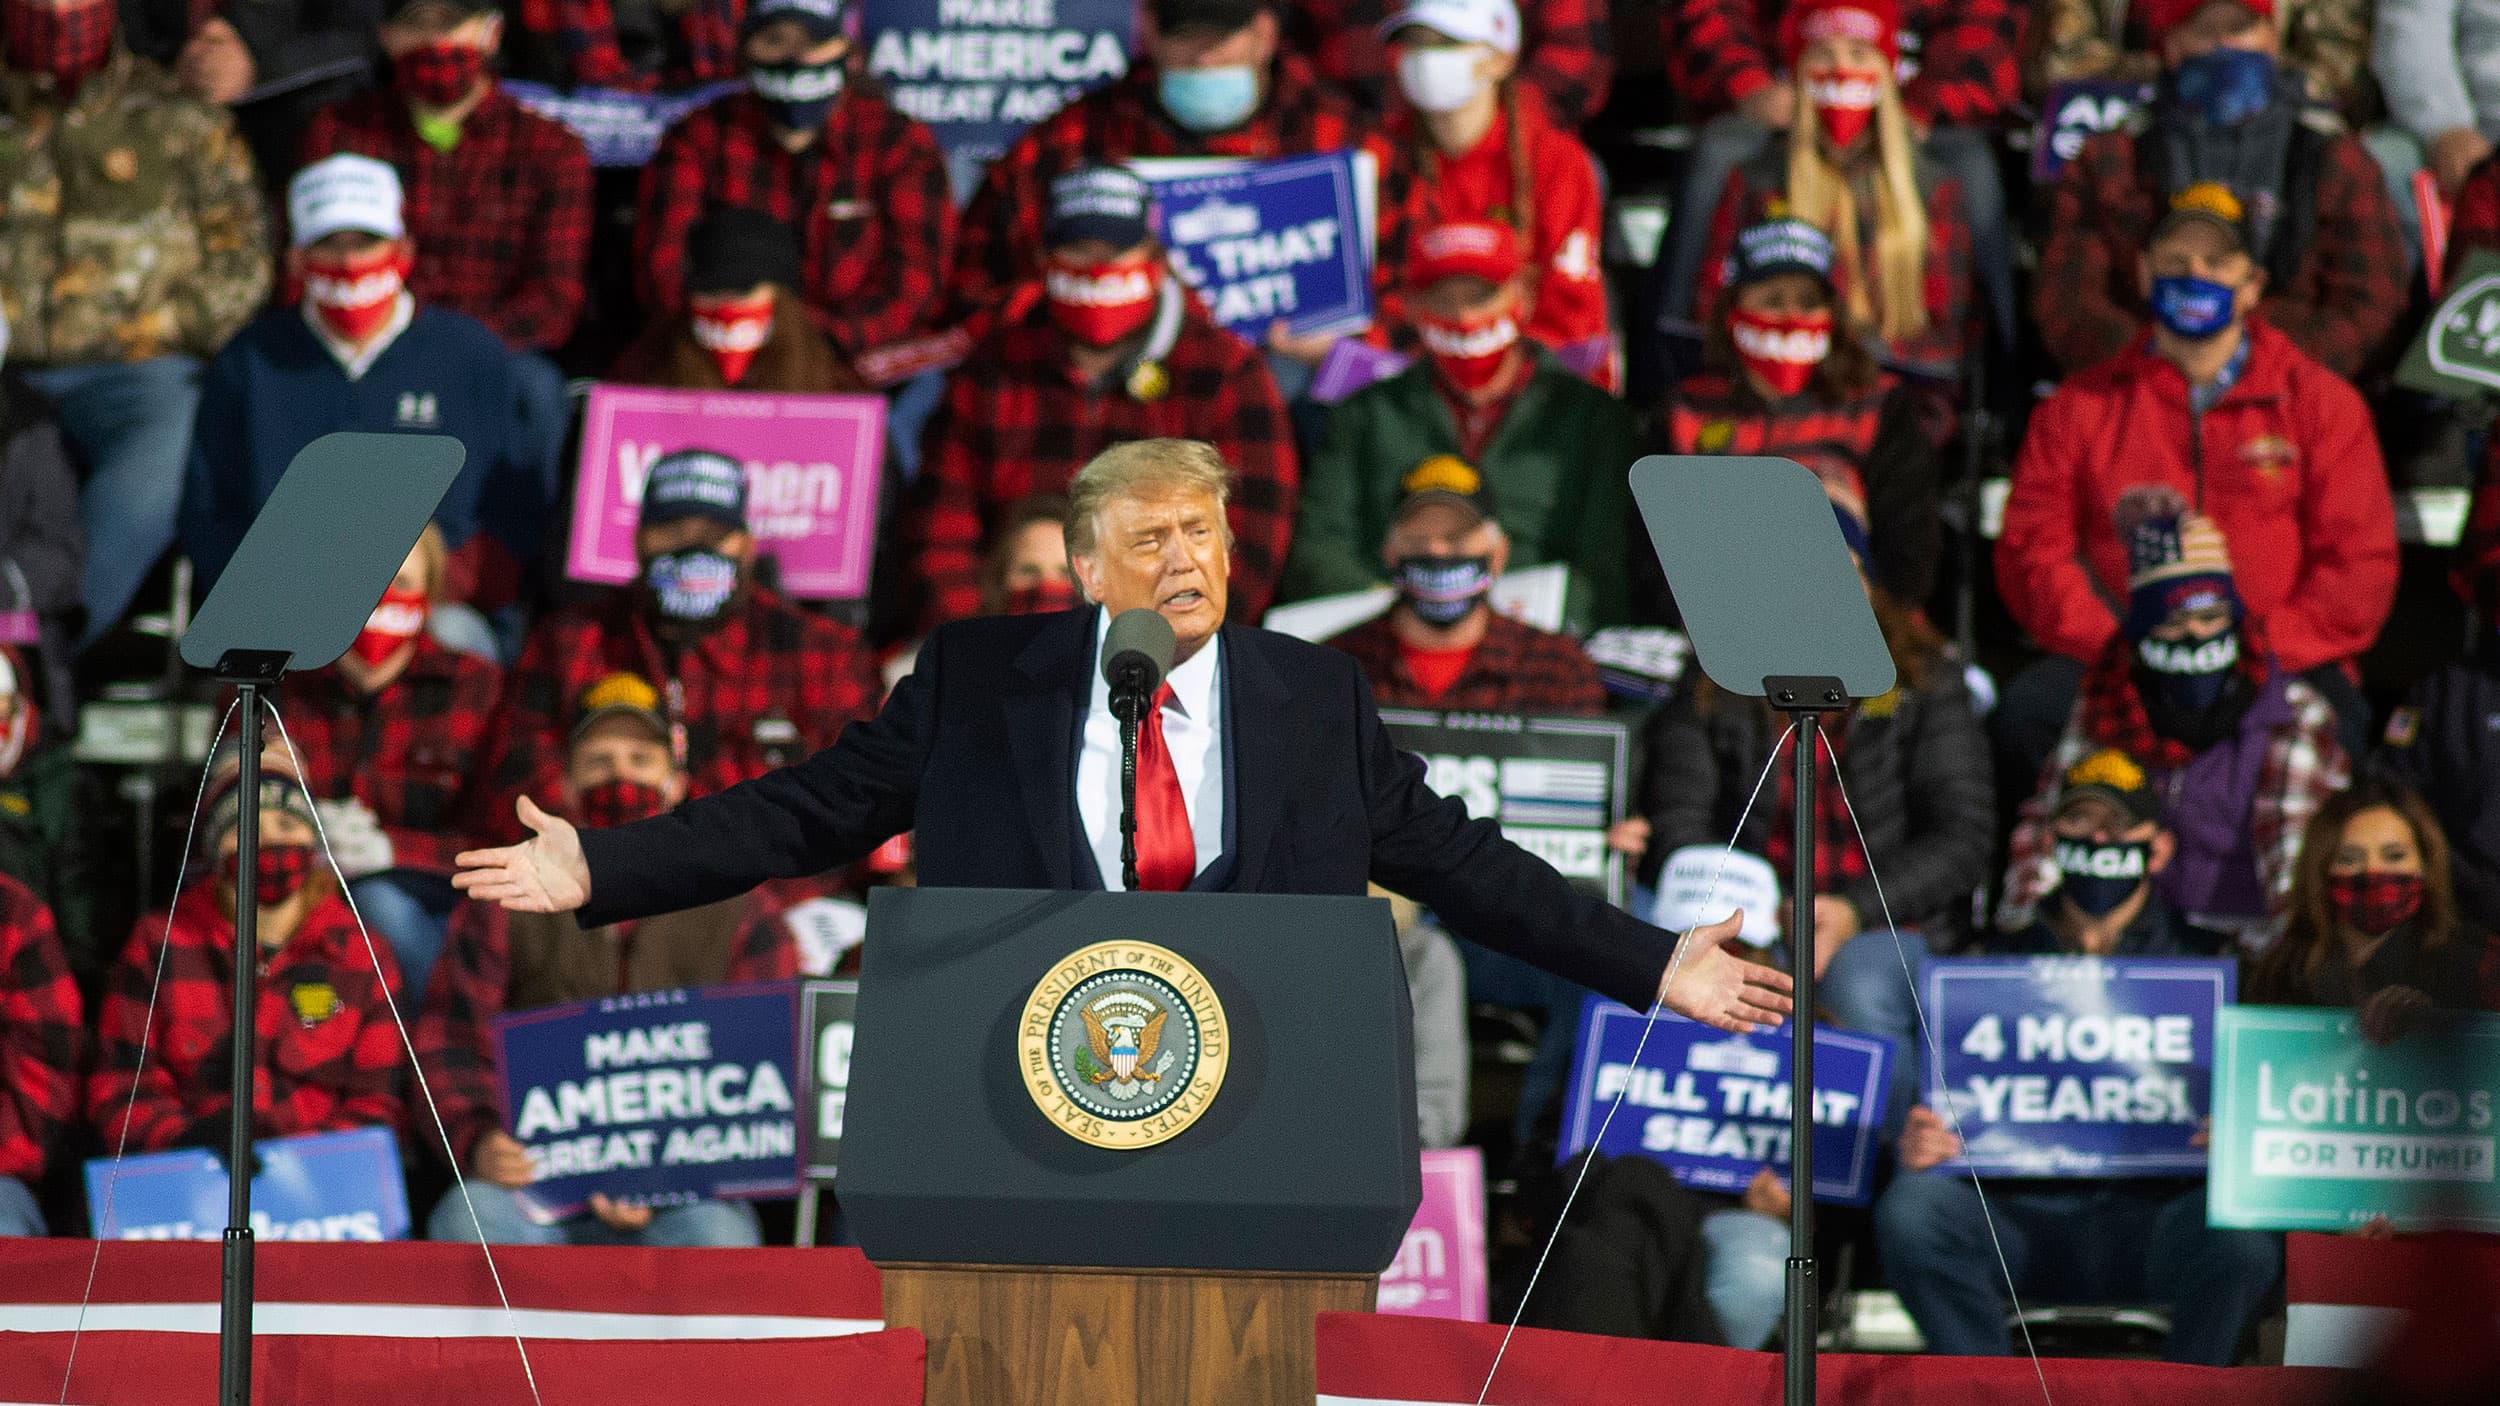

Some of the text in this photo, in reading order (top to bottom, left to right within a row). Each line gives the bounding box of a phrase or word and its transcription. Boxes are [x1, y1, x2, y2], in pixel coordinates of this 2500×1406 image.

[869, 29, 1128, 79] AMERICA
[1207, 219, 1337, 279] THAT
[585, 1021, 711, 1069] MAKE
[1026, 949, 1222, 1139] SEAL OF THE PRESIDENT OF THE UNITED STATES
[1960, 1015, 2193, 1063] 4 MORE
[516, 1060, 794, 1137] AMERICA
[1596, 1061, 1708, 1112] FILL
[2257, 1059, 2495, 1128] Latinos
[661, 1119, 795, 1165] AGAIN
[2265, 1140, 2484, 1172] FOR TRUMP
